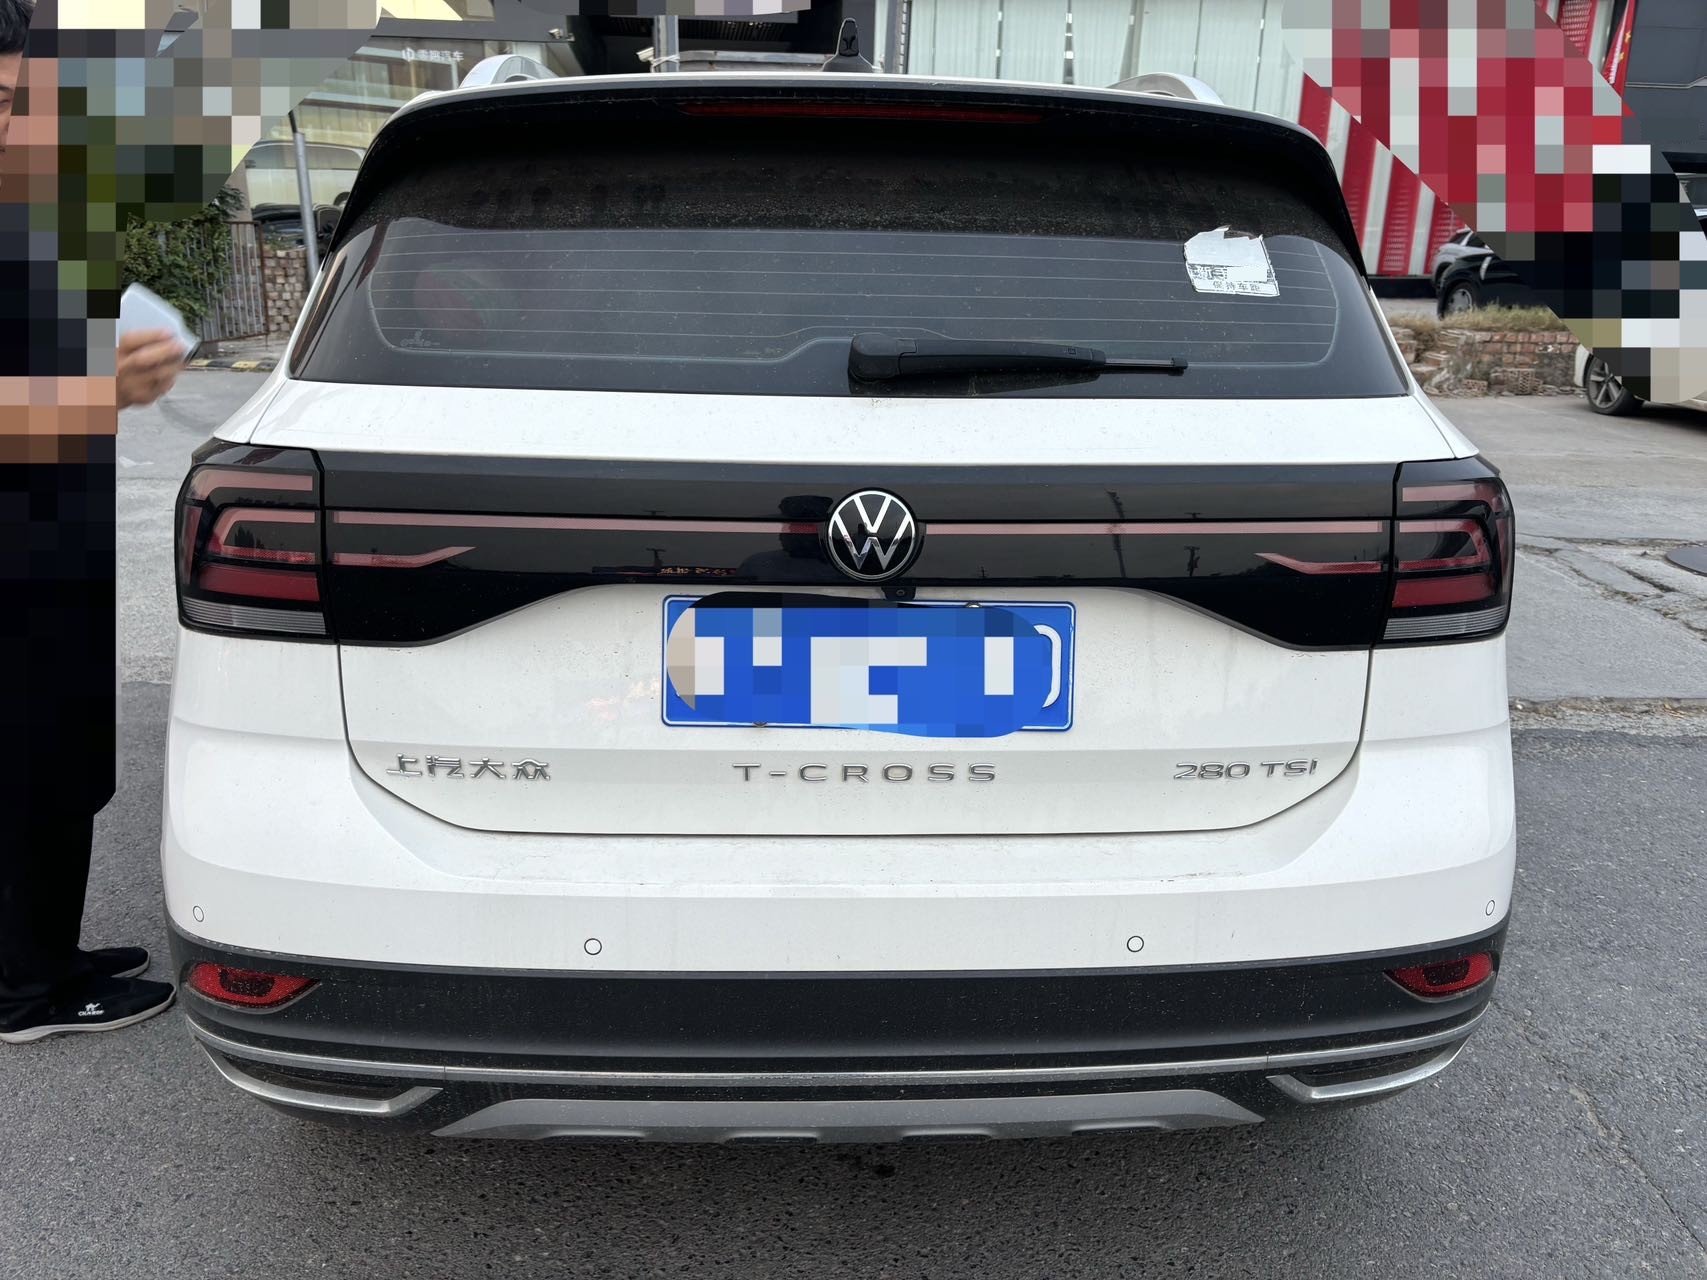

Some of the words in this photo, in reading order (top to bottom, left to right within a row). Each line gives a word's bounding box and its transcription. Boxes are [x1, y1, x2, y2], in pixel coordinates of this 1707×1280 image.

[387, 754, 550, 780] 上汽大众
[732, 762, 996, 782] T-CROSS
[1174, 762, 1250, 780] 280
[1261, 758, 1318, 778] TSI
